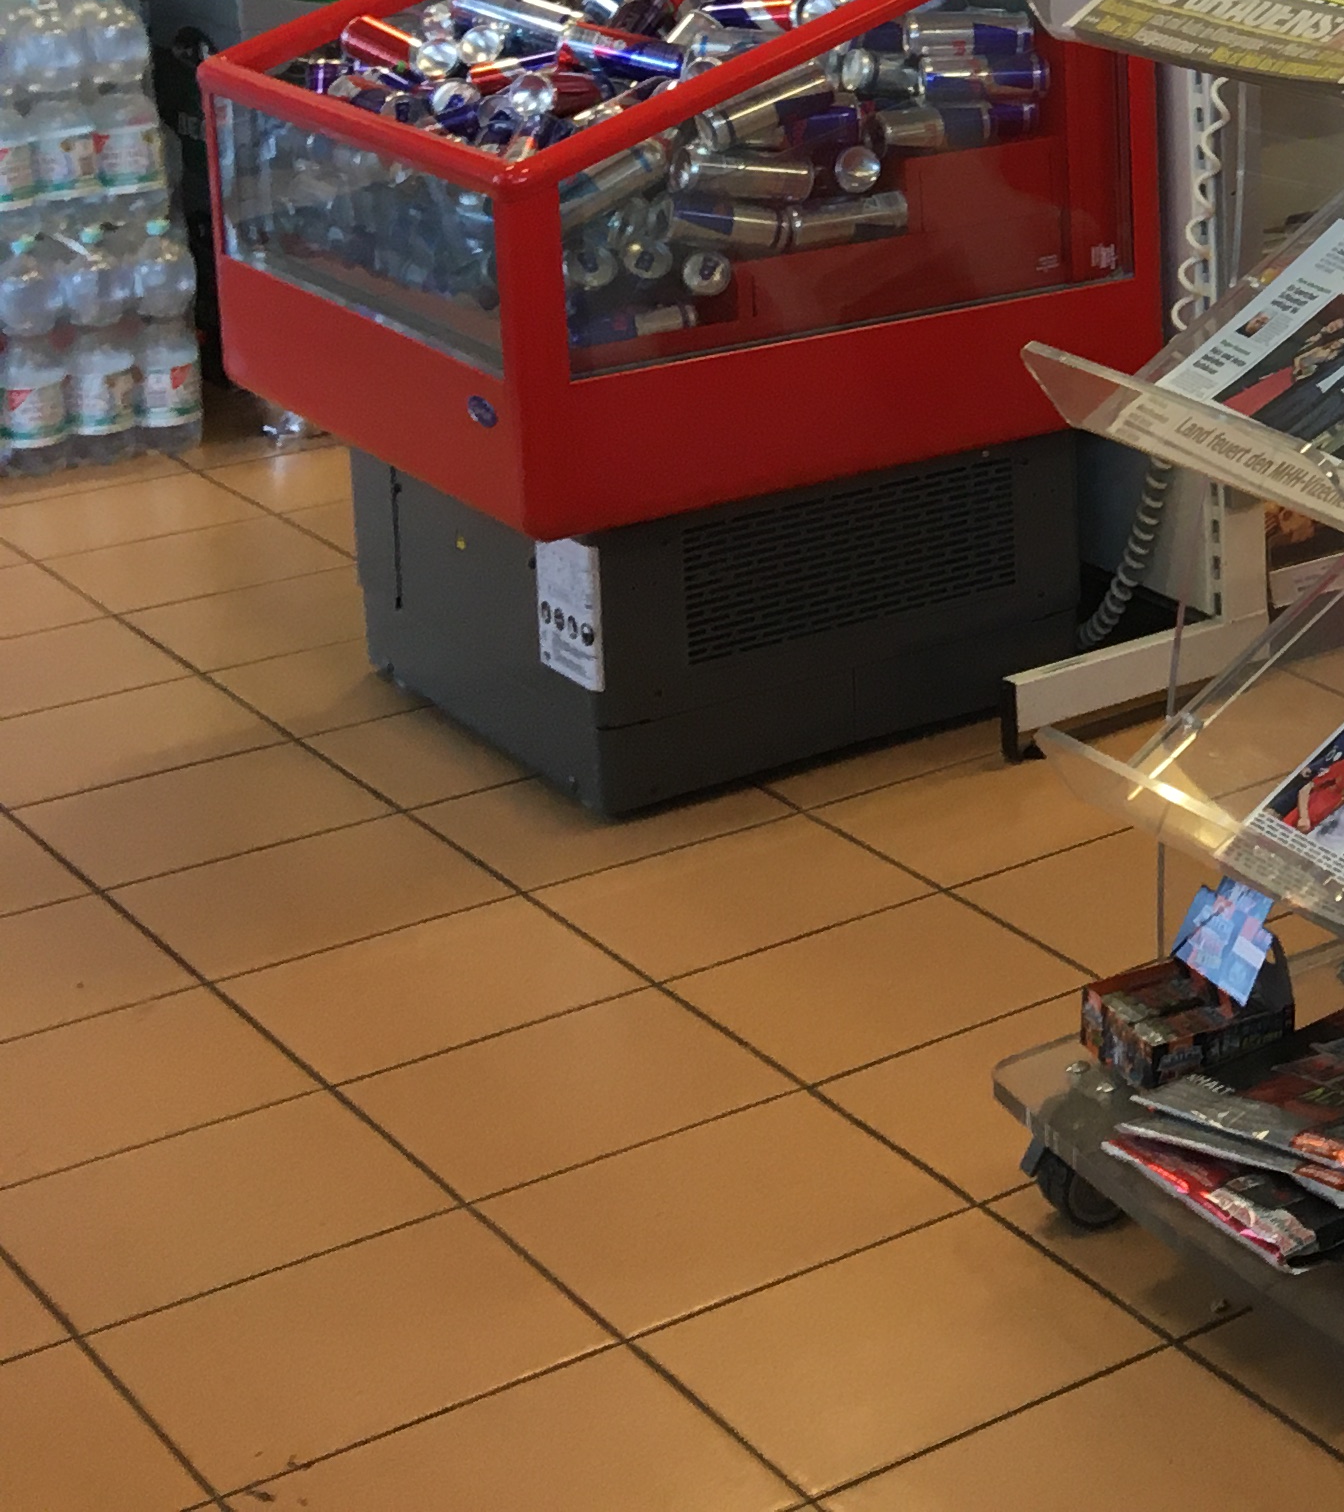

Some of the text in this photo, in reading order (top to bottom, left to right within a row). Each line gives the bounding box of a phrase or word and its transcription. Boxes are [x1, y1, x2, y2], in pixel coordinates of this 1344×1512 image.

[1174, 415, 1276, 475] Land feuert den
